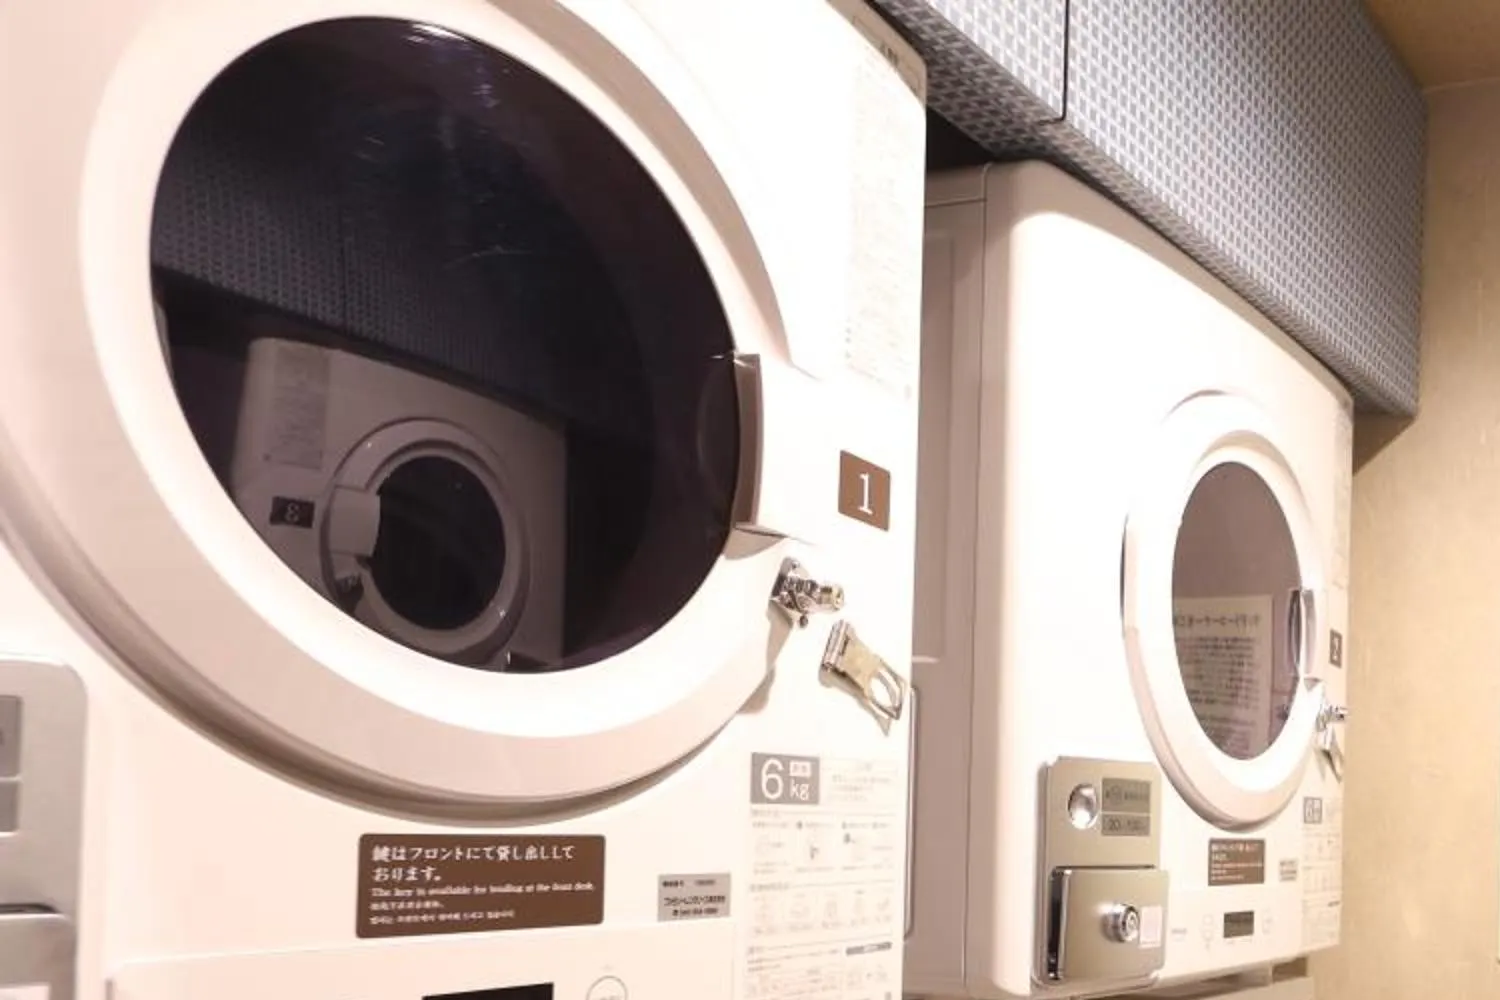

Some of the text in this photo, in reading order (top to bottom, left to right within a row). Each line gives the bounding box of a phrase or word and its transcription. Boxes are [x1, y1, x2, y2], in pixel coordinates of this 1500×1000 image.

[858, 471, 874, 515] 1
[762, 758, 809, 800] 6 kg
[371, 844, 575, 862] 鍵はフロントにて貸し出しして
[373, 866, 442, 882] おります。
